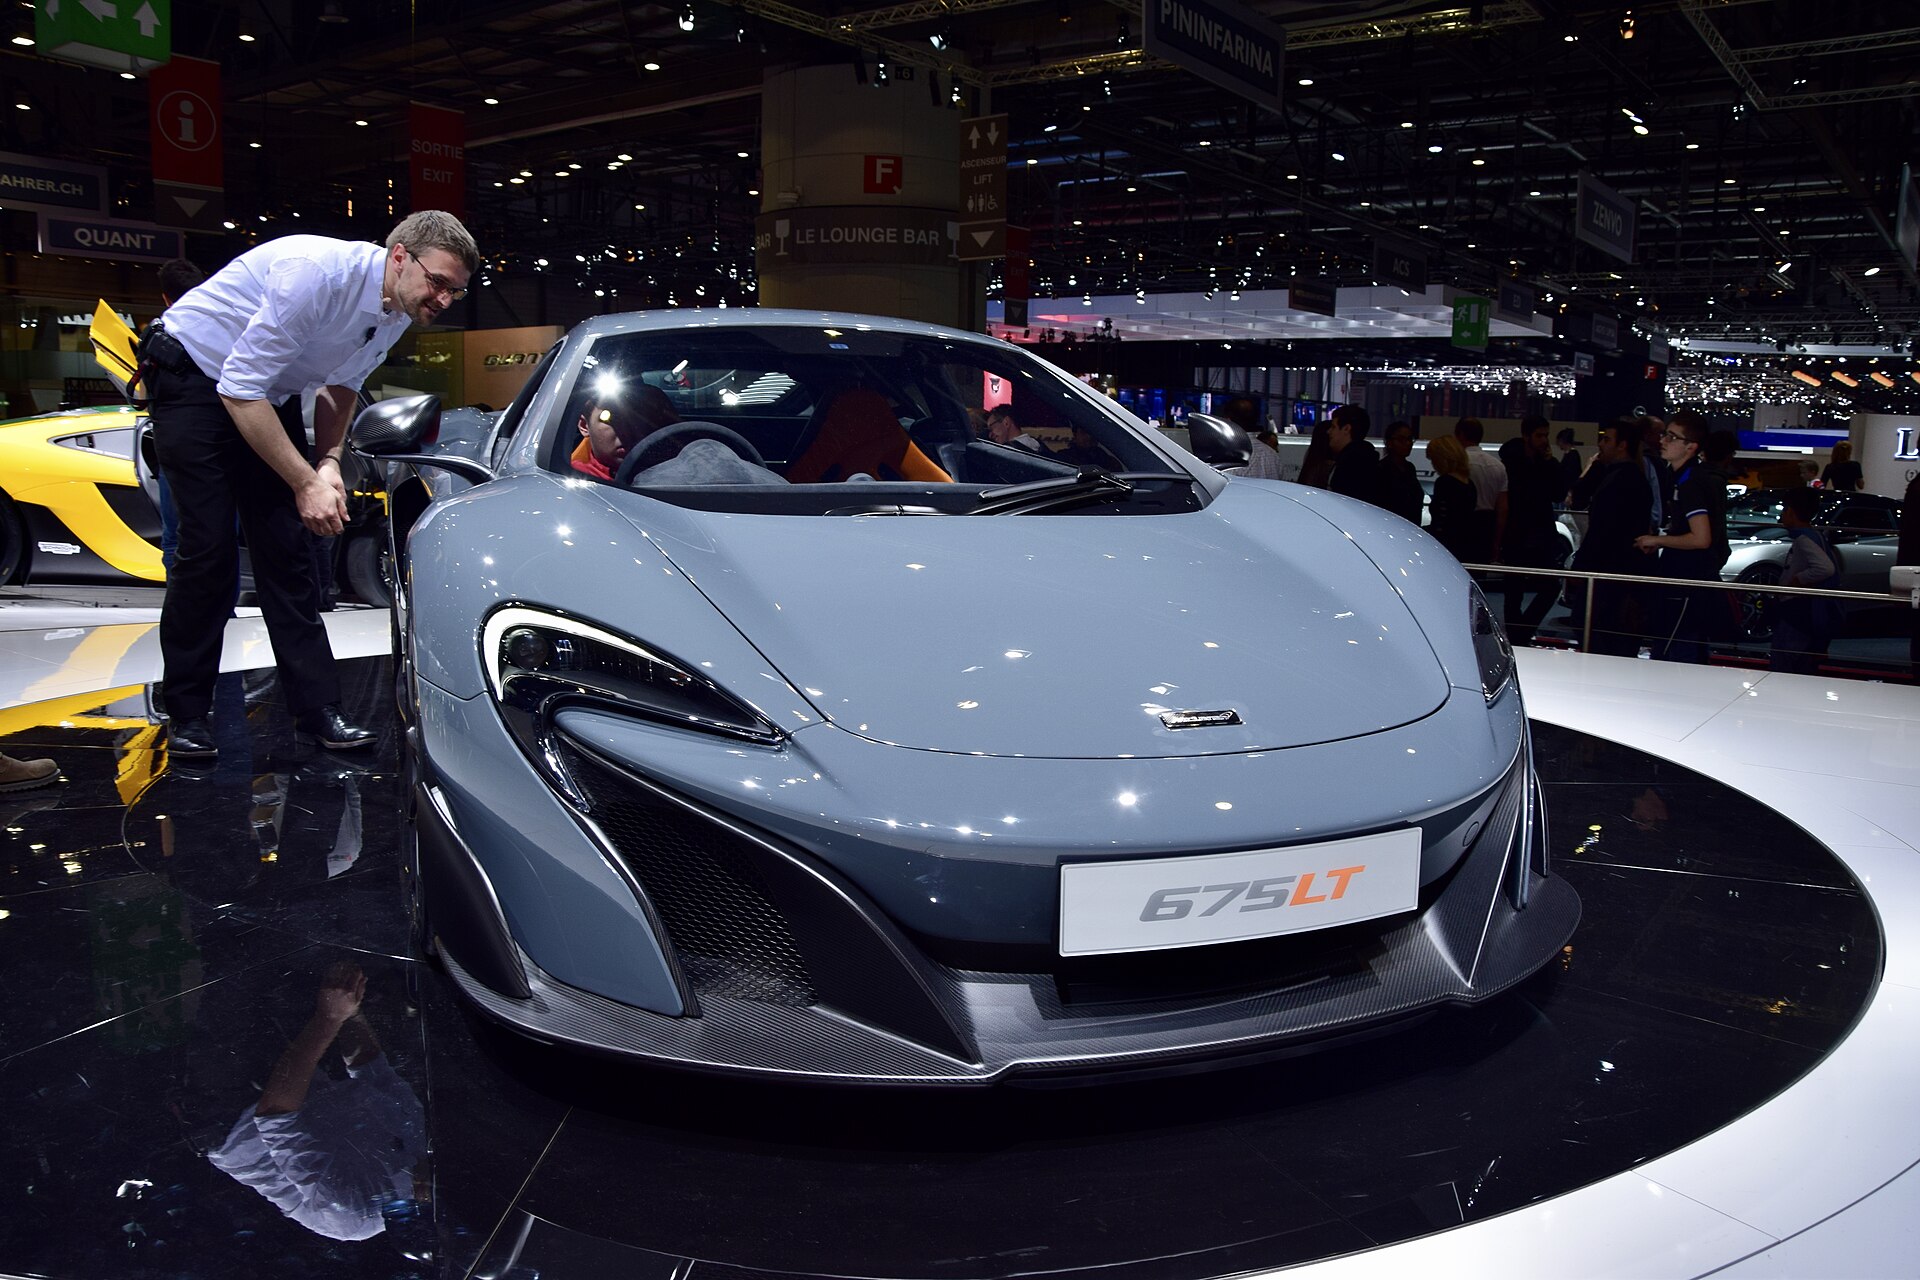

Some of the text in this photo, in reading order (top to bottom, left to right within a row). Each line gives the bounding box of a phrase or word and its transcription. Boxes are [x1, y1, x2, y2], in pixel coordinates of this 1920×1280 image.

[1160, 0, 1274, 78] PININFARINA
[411, 139, 464, 160] SORTIE
[875, 158, 895, 185] F
[961, 155, 1007, 169] ASCENSEUR
[422, 168, 455, 184] EXIT
[973, 173, 993, 185] LIFT
[1592, 200, 1622, 237] ZENVO
[74, 227, 156, 250] QUANT
[796, 227, 941, 246] LE LOUNGE BAR
[1647, 366, 1655, 377] F
[1139, 865, 1366, 922] 675LT
